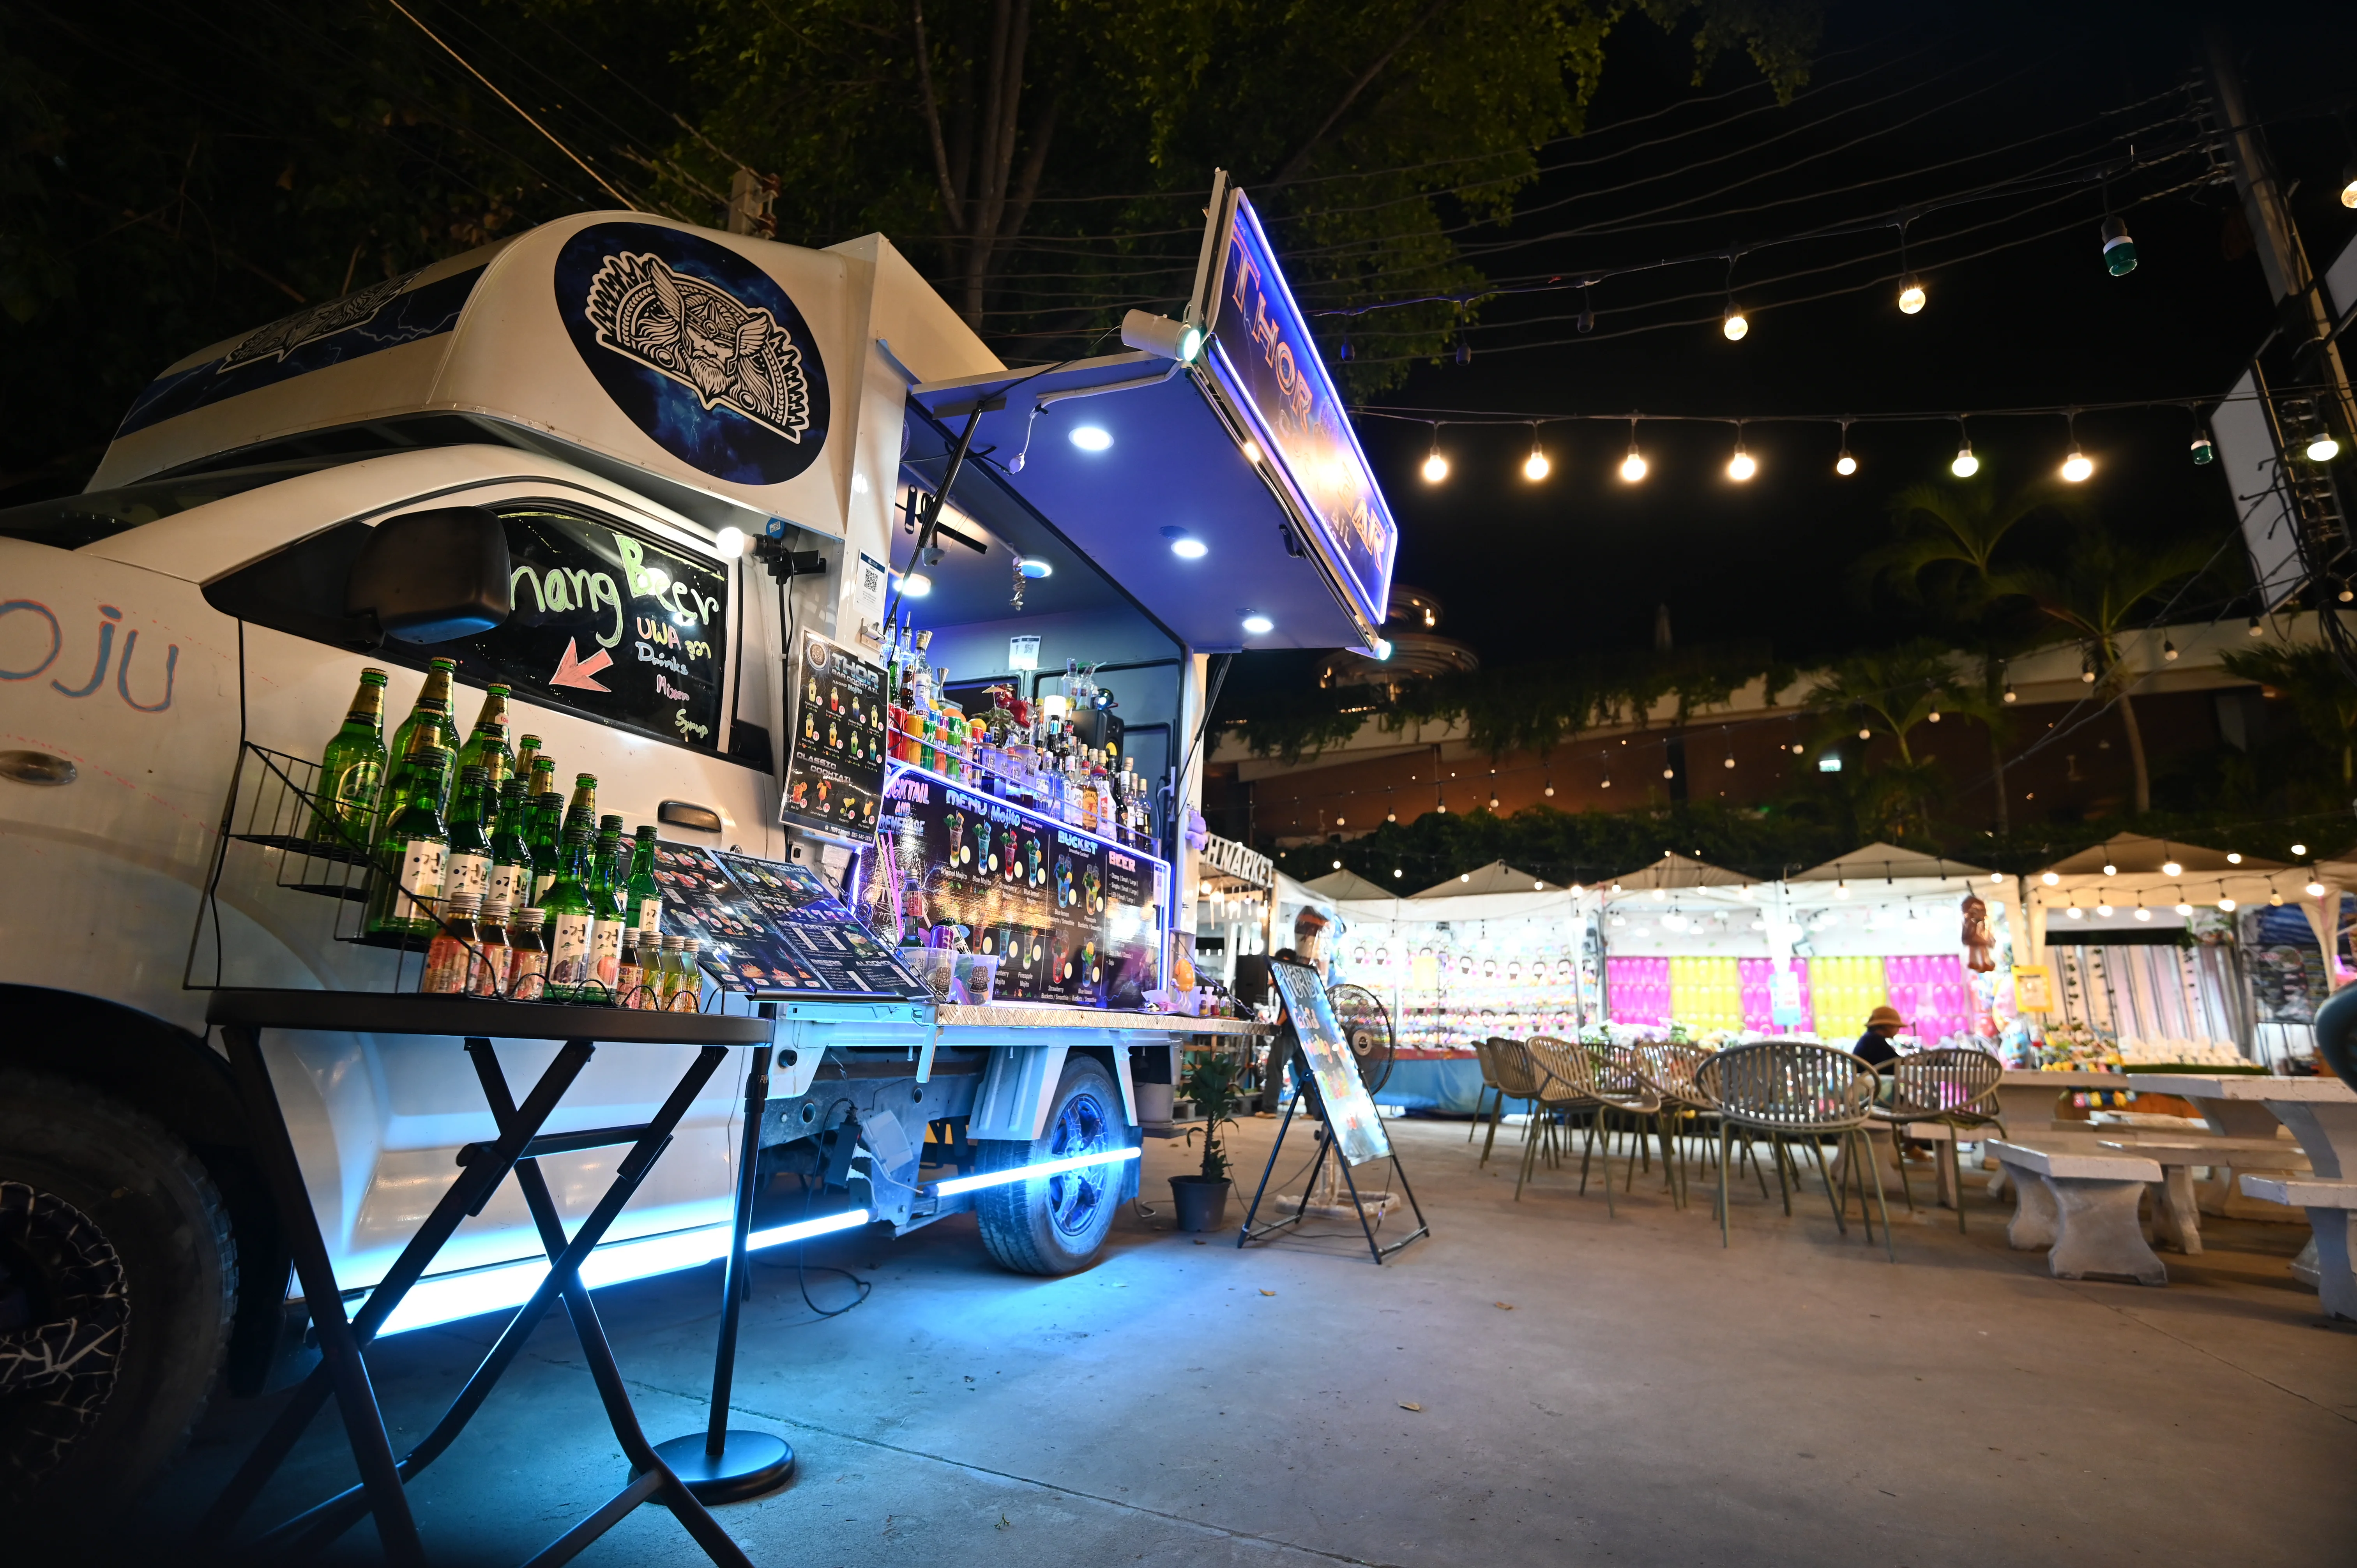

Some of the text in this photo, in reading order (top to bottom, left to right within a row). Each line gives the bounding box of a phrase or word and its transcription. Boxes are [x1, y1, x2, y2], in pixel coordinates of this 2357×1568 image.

[612, 533, 719, 625] Beer
[832, 652, 879, 689] THOR
[847, 683, 862, 695] Mojito
[797, 751, 837, 770] CLASSIC
[895, 800, 911, 816] AND
[946, 789, 988, 816] MENU
[990, 805, 1020, 829] Mojito
[1058, 830, 1098, 855] BUCKET
[1109, 851, 1136, 872] BEER
[941, 867, 967, 880] Original Mojito
[981, 876, 991, 886] Mojito
